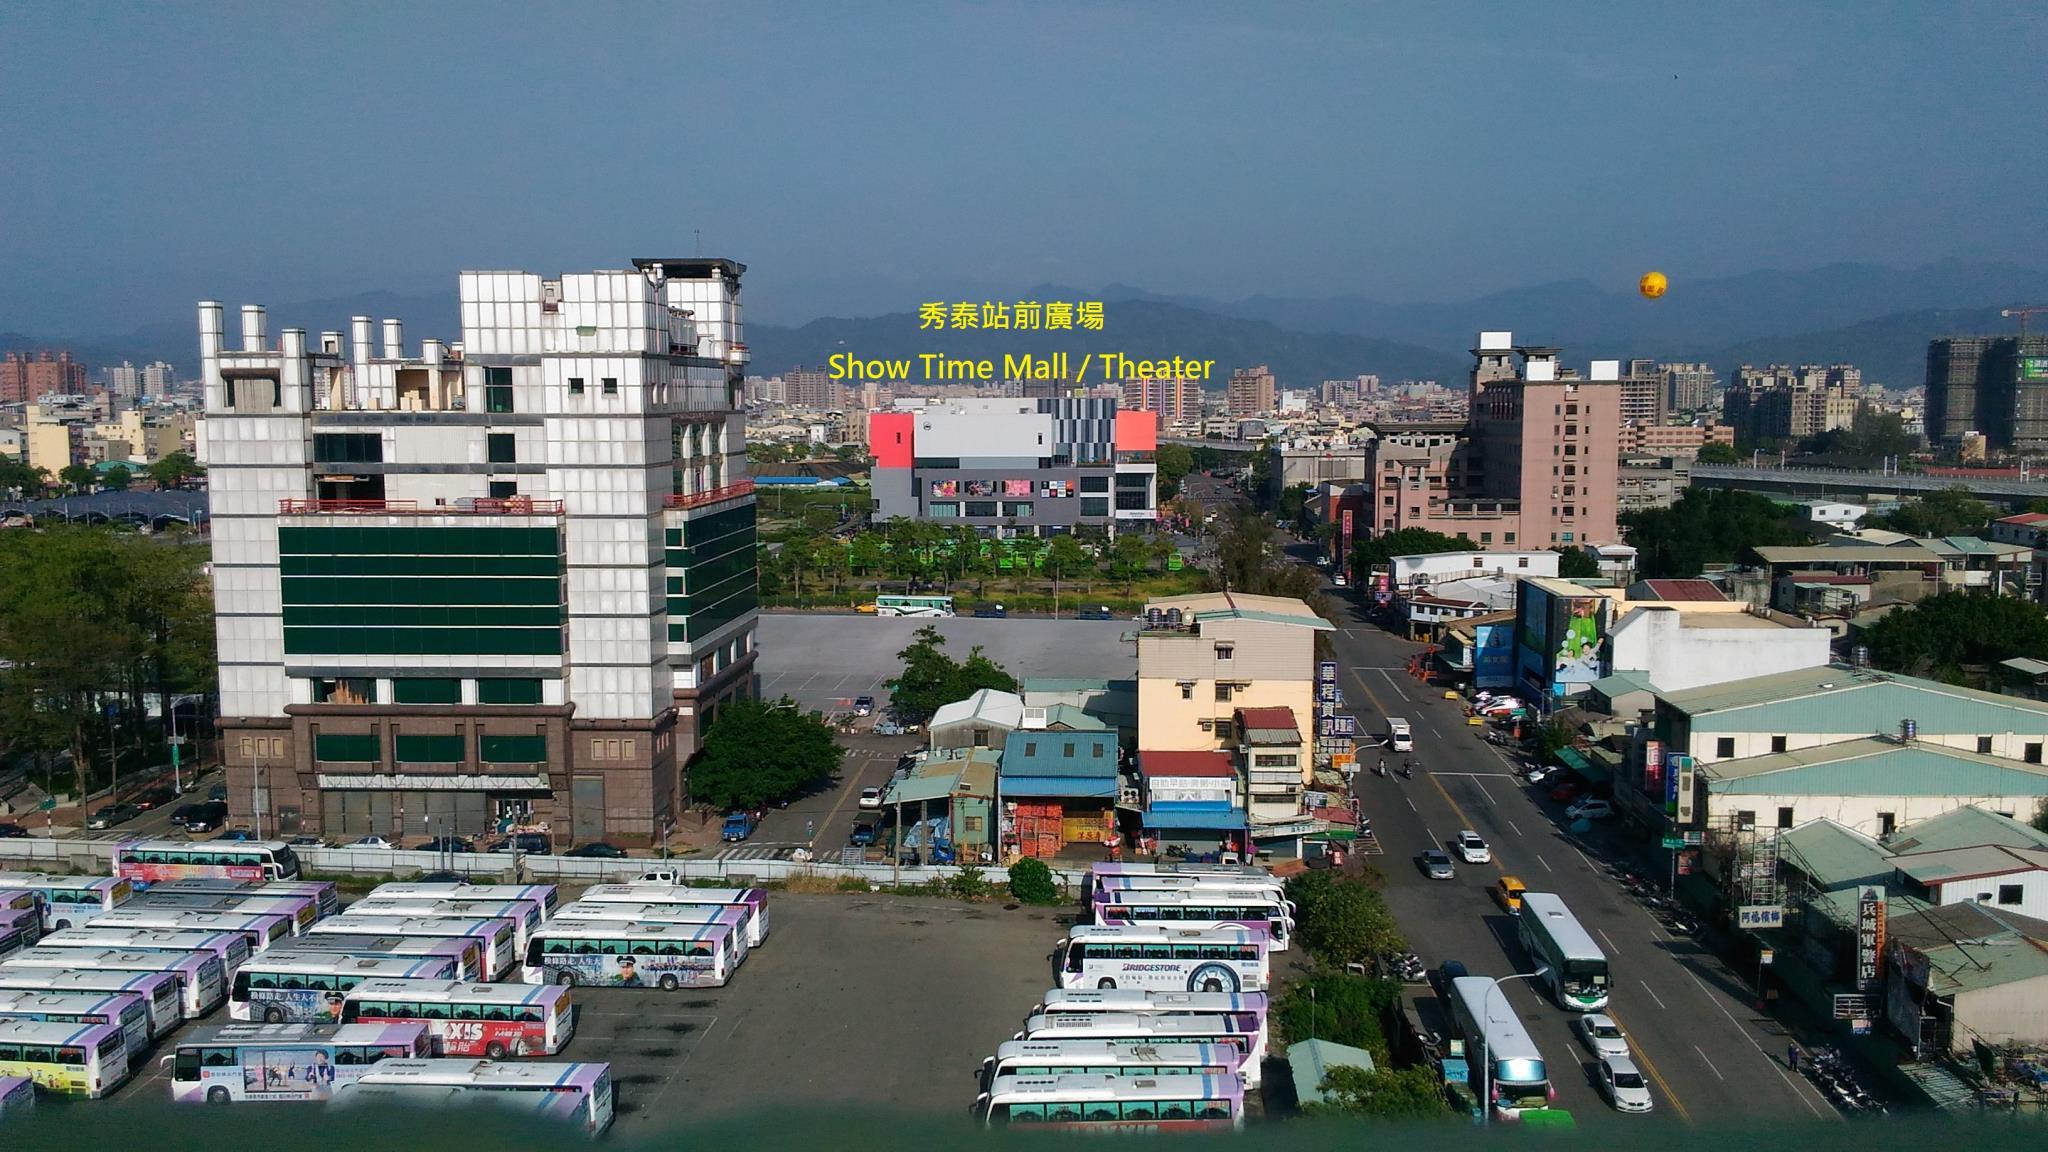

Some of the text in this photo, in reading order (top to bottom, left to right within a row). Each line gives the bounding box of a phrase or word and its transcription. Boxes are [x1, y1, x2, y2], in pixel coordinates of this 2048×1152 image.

[1321, 666, 1336, 736] 華程資訊
[1122, 962, 1182, 972] BRIDGESTONE
